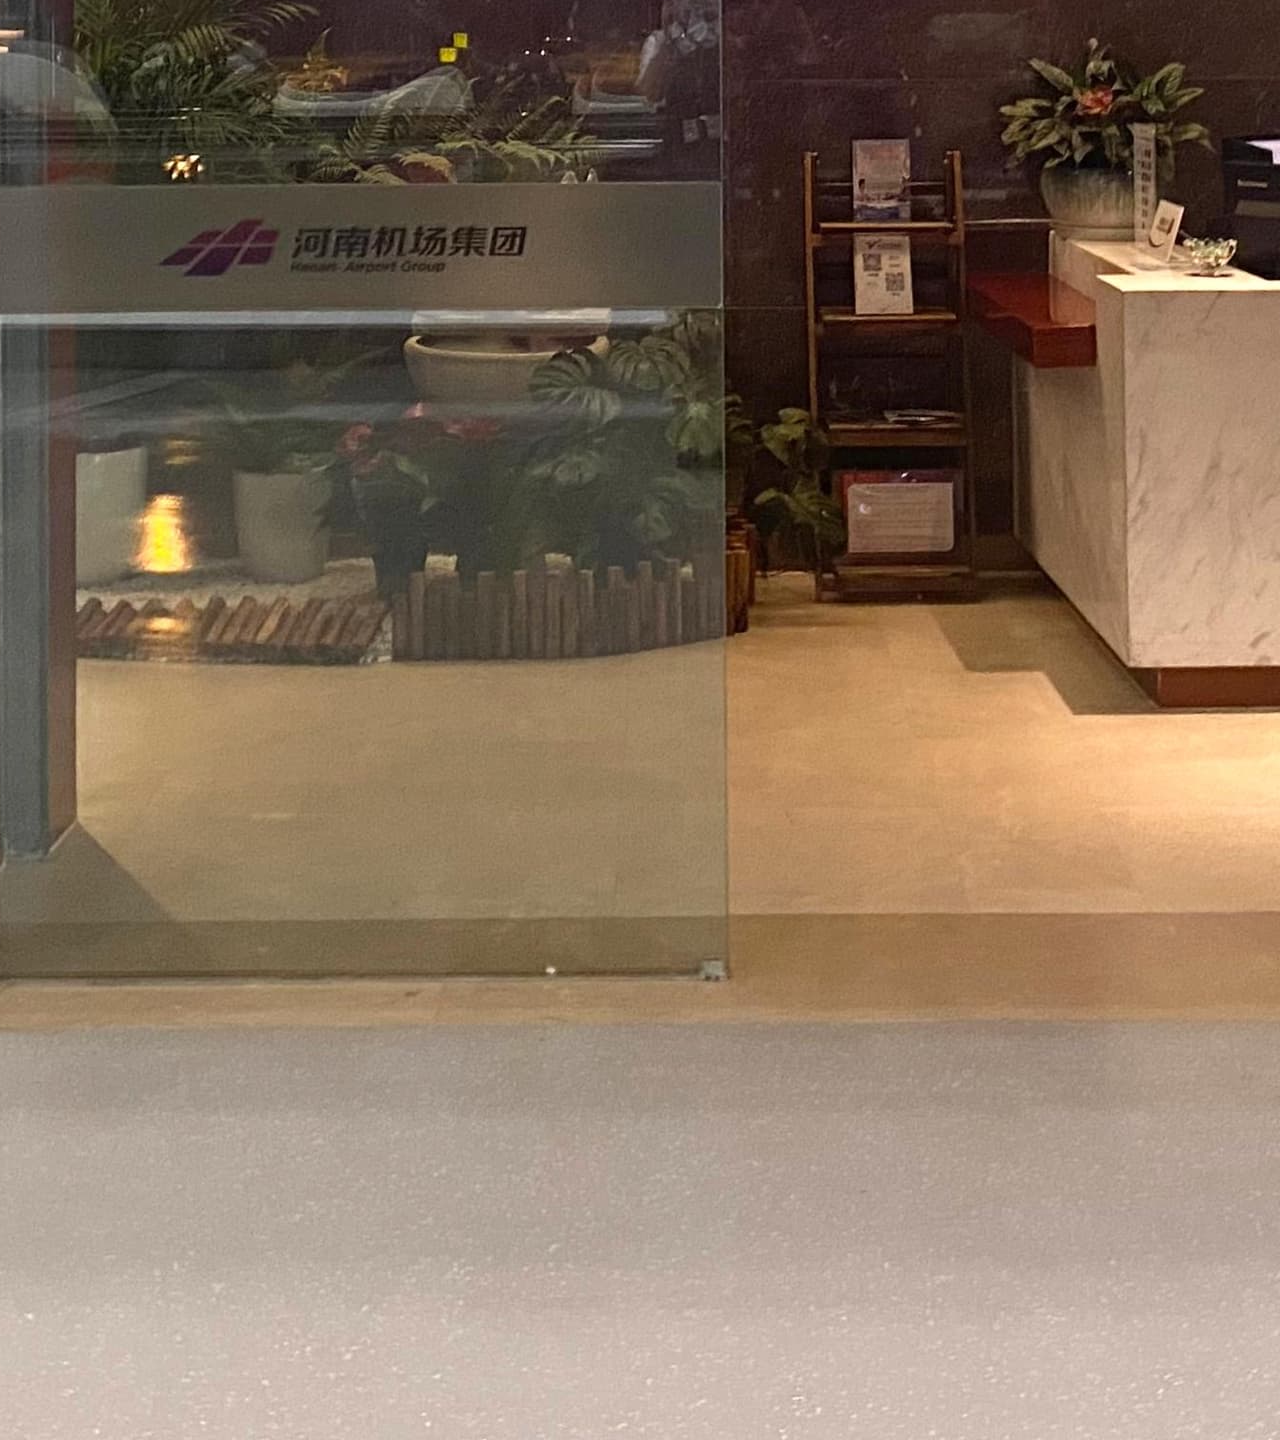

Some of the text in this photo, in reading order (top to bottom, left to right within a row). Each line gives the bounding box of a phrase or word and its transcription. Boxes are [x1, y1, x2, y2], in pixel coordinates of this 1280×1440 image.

[291, 226, 528, 259] 河南机场集团
[343, 261, 397, 274] Airport
[400, 261, 446, 274] Group
